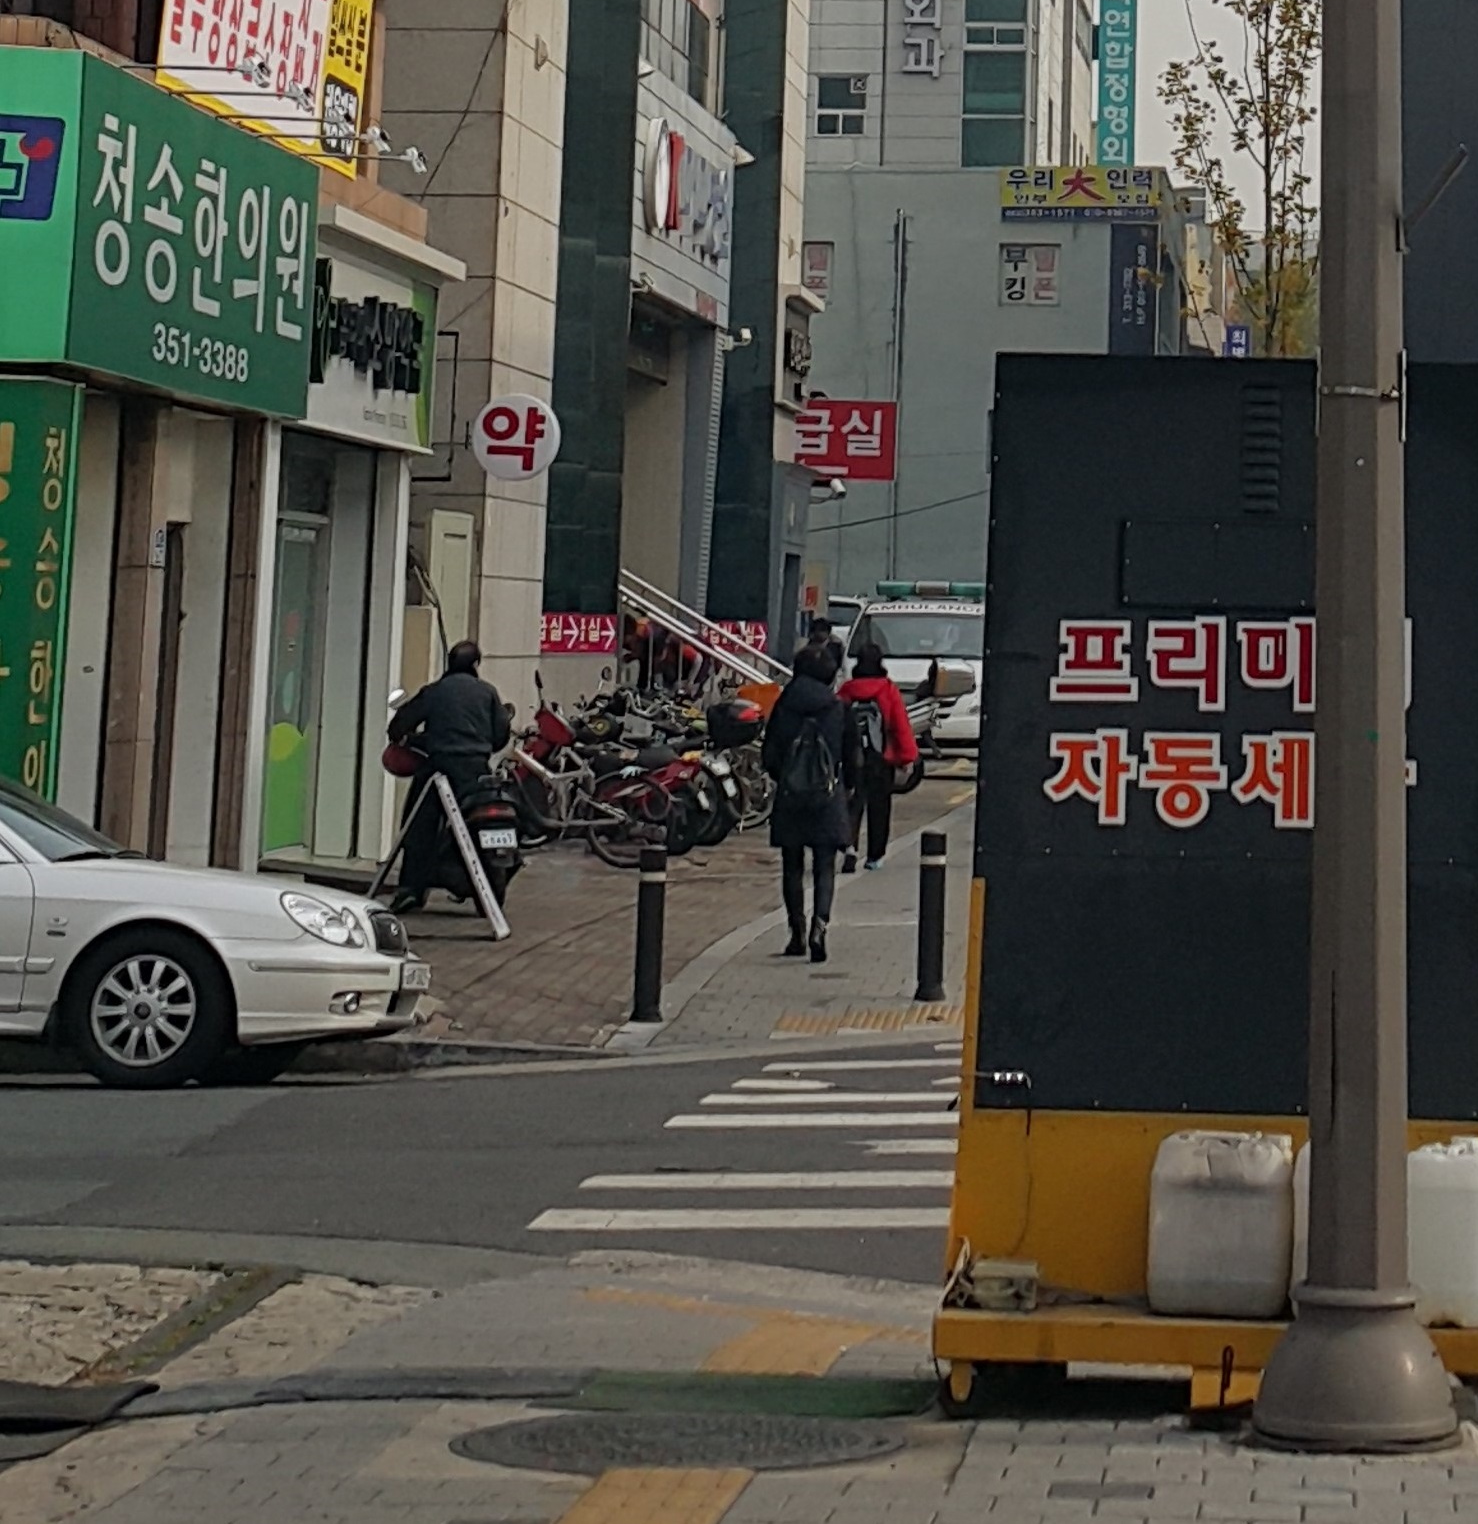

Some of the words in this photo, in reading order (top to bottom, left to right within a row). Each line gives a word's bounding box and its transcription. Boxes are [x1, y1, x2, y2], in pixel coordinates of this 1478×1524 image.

[1006, 169, 1053, 190] 우리
[1107, 169, 1153, 190] 인력
[93, 112, 309, 341] 청송한의원
[1004, 247, 1028, 300] 부킹
[152, 322, 249, 383] 351-3388
[482, 406, 546, 472] 약
[1049, 615, 1412, 713] 프리미
[1043, 727, 1418, 829] 자동세
